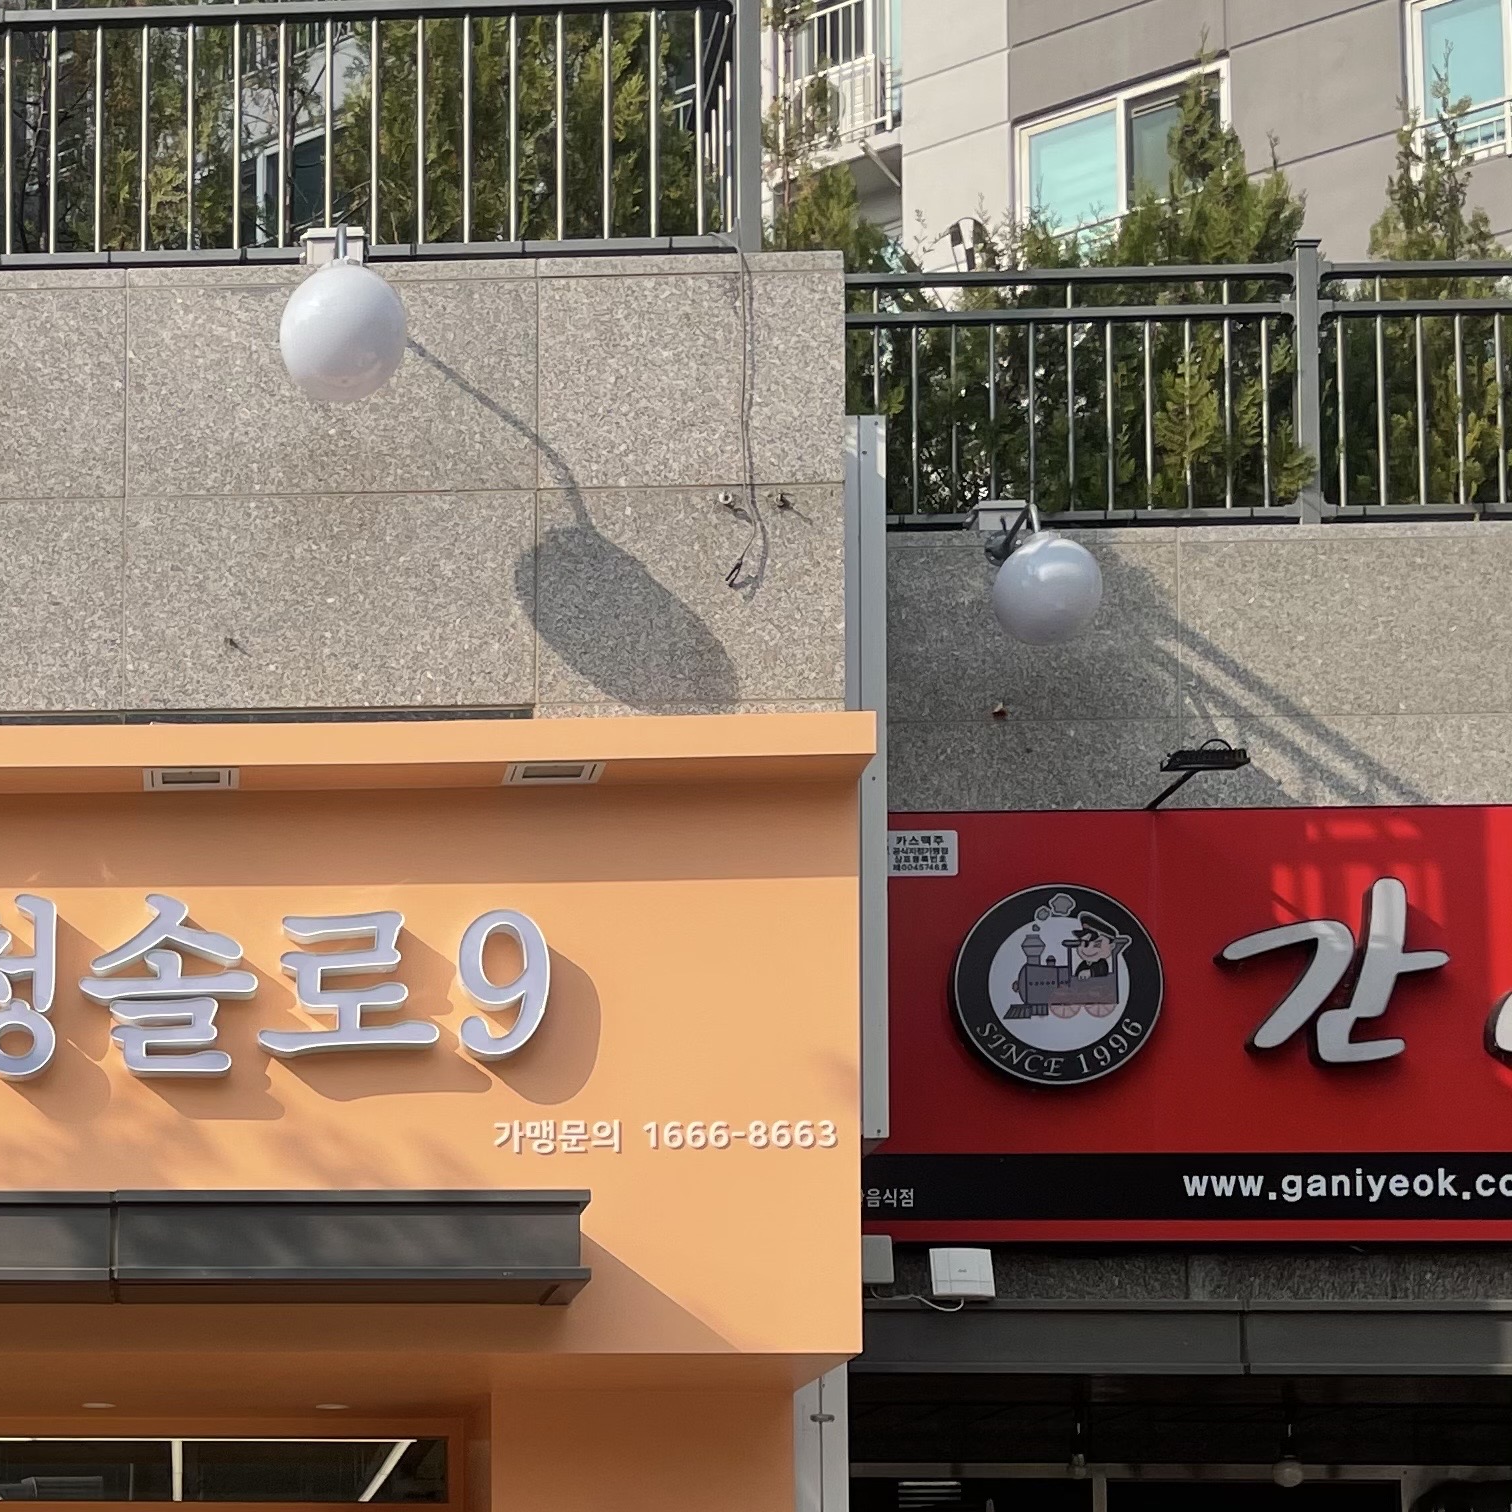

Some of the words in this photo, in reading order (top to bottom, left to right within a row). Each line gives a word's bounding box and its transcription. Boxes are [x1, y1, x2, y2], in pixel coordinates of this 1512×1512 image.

[976, 1022, 1065, 1077] SINCE
[1077, 1018, 1143, 1074] 1996
[493, 1119, 623, 1154] 가맹문의
[643, 1119, 839, 1150] 1666-8663
[861, 1188, 914, 1207] 음식점
